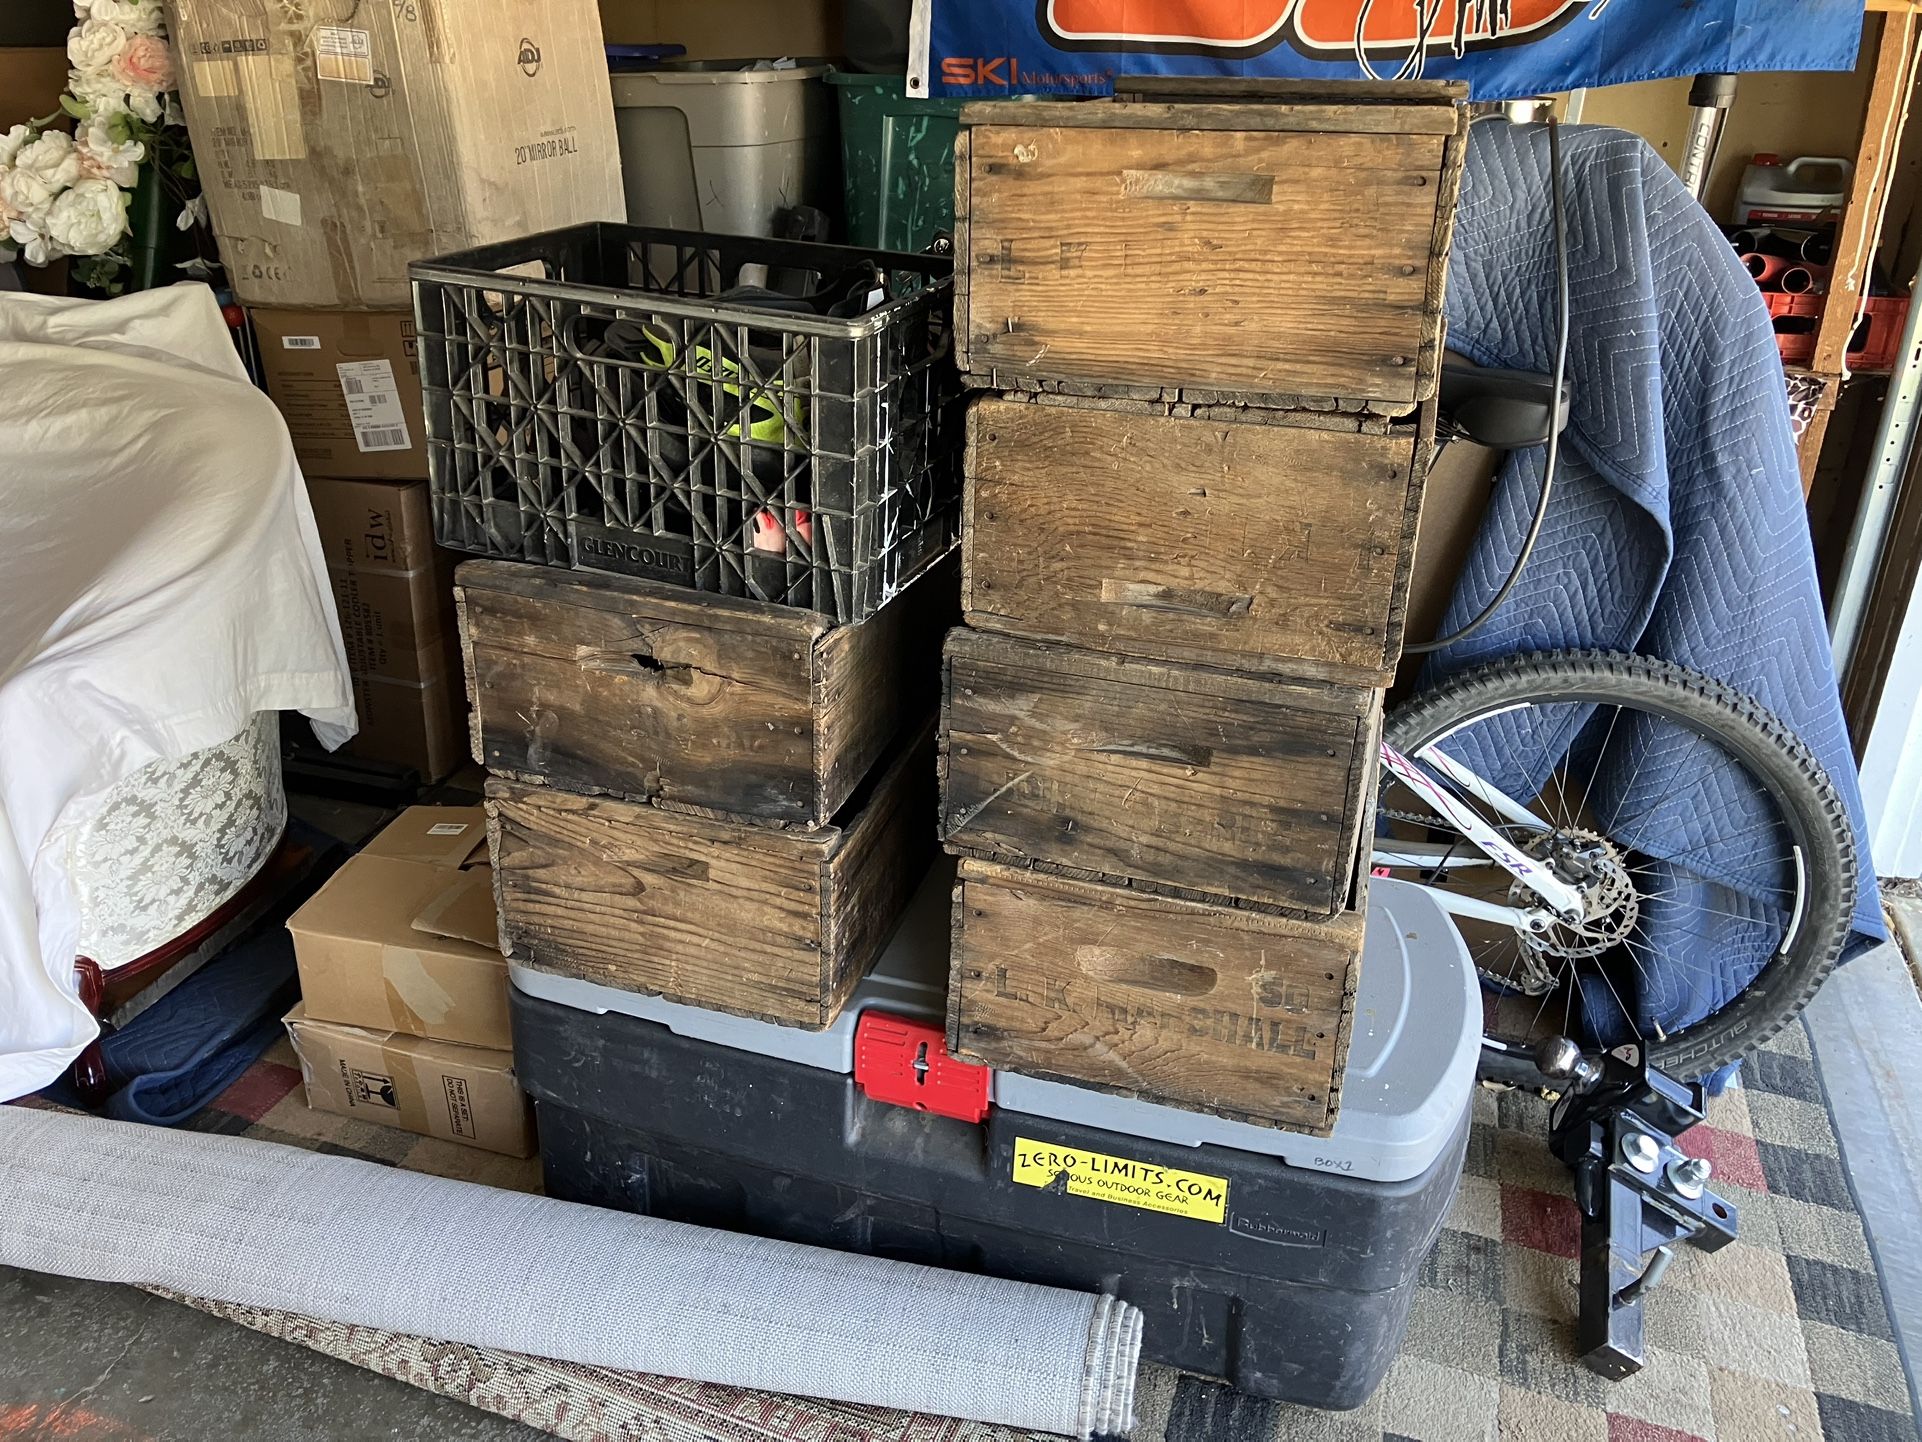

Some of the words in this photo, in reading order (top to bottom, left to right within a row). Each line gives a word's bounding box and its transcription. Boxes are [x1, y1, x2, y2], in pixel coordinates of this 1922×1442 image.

[941, 57, 1017, 86] SKI
[344, 537, 356, 577] TPPER
[1018, 1152, 1222, 1207] ZERO-LIMITS.COM
[1097, 1179, 1151, 1198] OUTDOOR
[1155, 1191, 1189, 1206] GEAR
[1091, 1189, 1106, 1198] and
[1107, 1192, 1141, 1205] Business
[1142, 1200, 1189, 1214] Accessories
[1237, 1217, 1321, 1241] Rubbermaid
